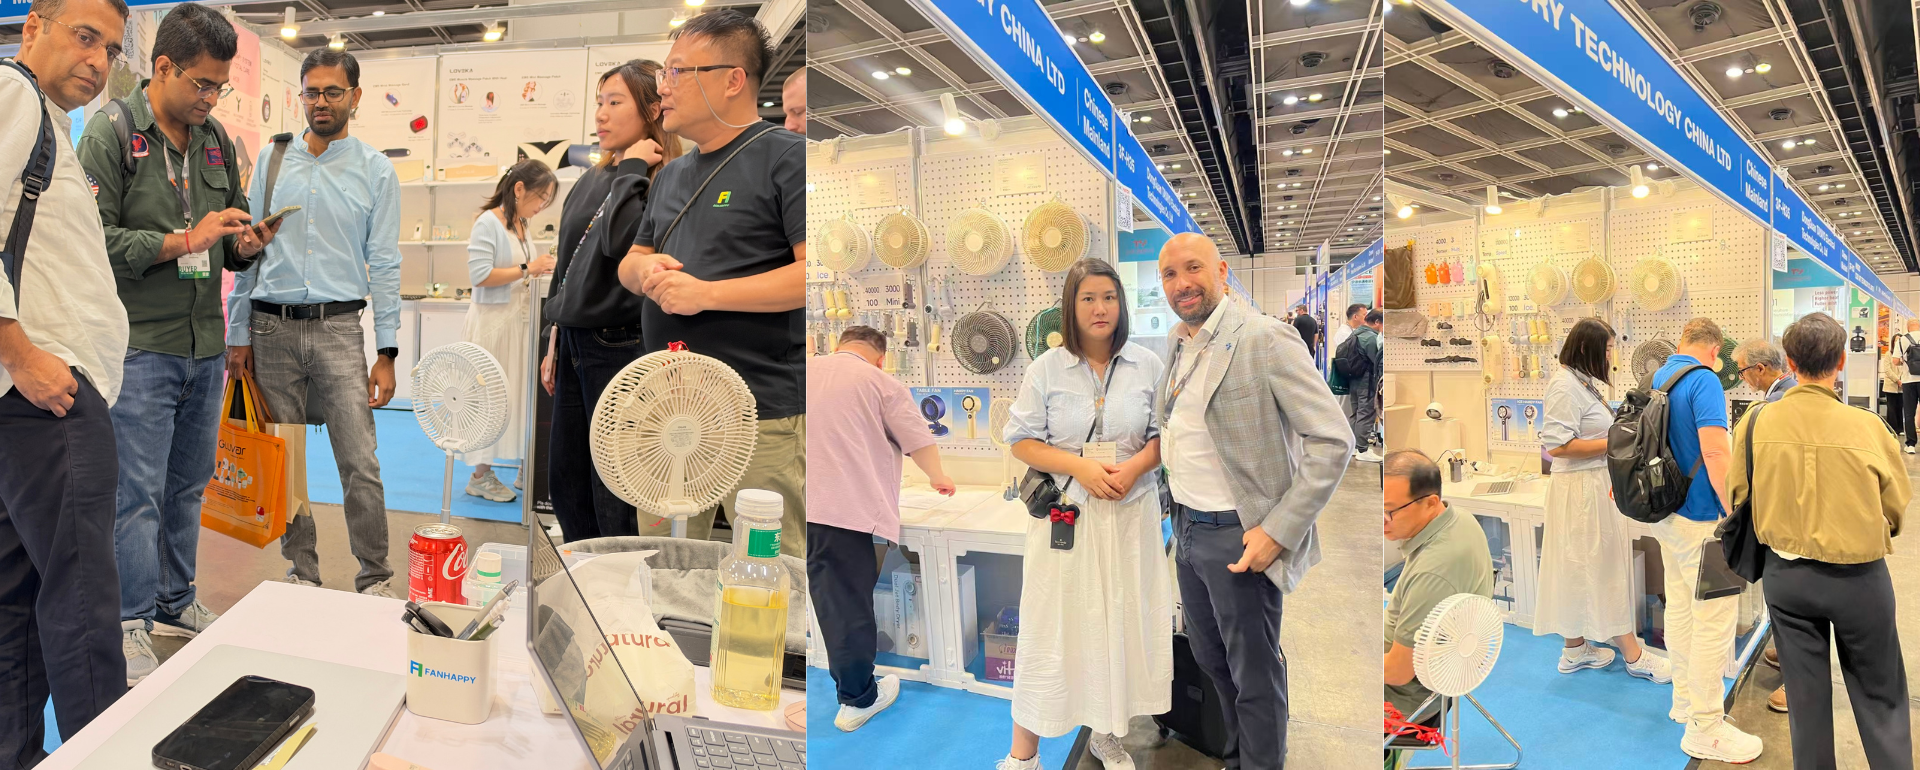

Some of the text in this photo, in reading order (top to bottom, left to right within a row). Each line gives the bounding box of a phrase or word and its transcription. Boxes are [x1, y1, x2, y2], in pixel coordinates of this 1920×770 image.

[1001, 4, 1045, 74] CHINA
[1046, 56, 1066, 95] LTD
[1519, 0, 1732, 171] RY TECHNOLOGY CHINA LTD
[1083, 87, 1109, 131] Chinese
[1083, 115, 1111, 159] Mainland
[1746, 158, 1768, 190] Chinese
[1745, 181, 1769, 213] Mainland
[817, 271, 829, 279] Ice
[885, 285, 900, 293] 3000
[867, 297, 900, 307] 100 Mini
[425, 668, 476, 684] FANHAPPY
[644, 695, 688, 715] ural
